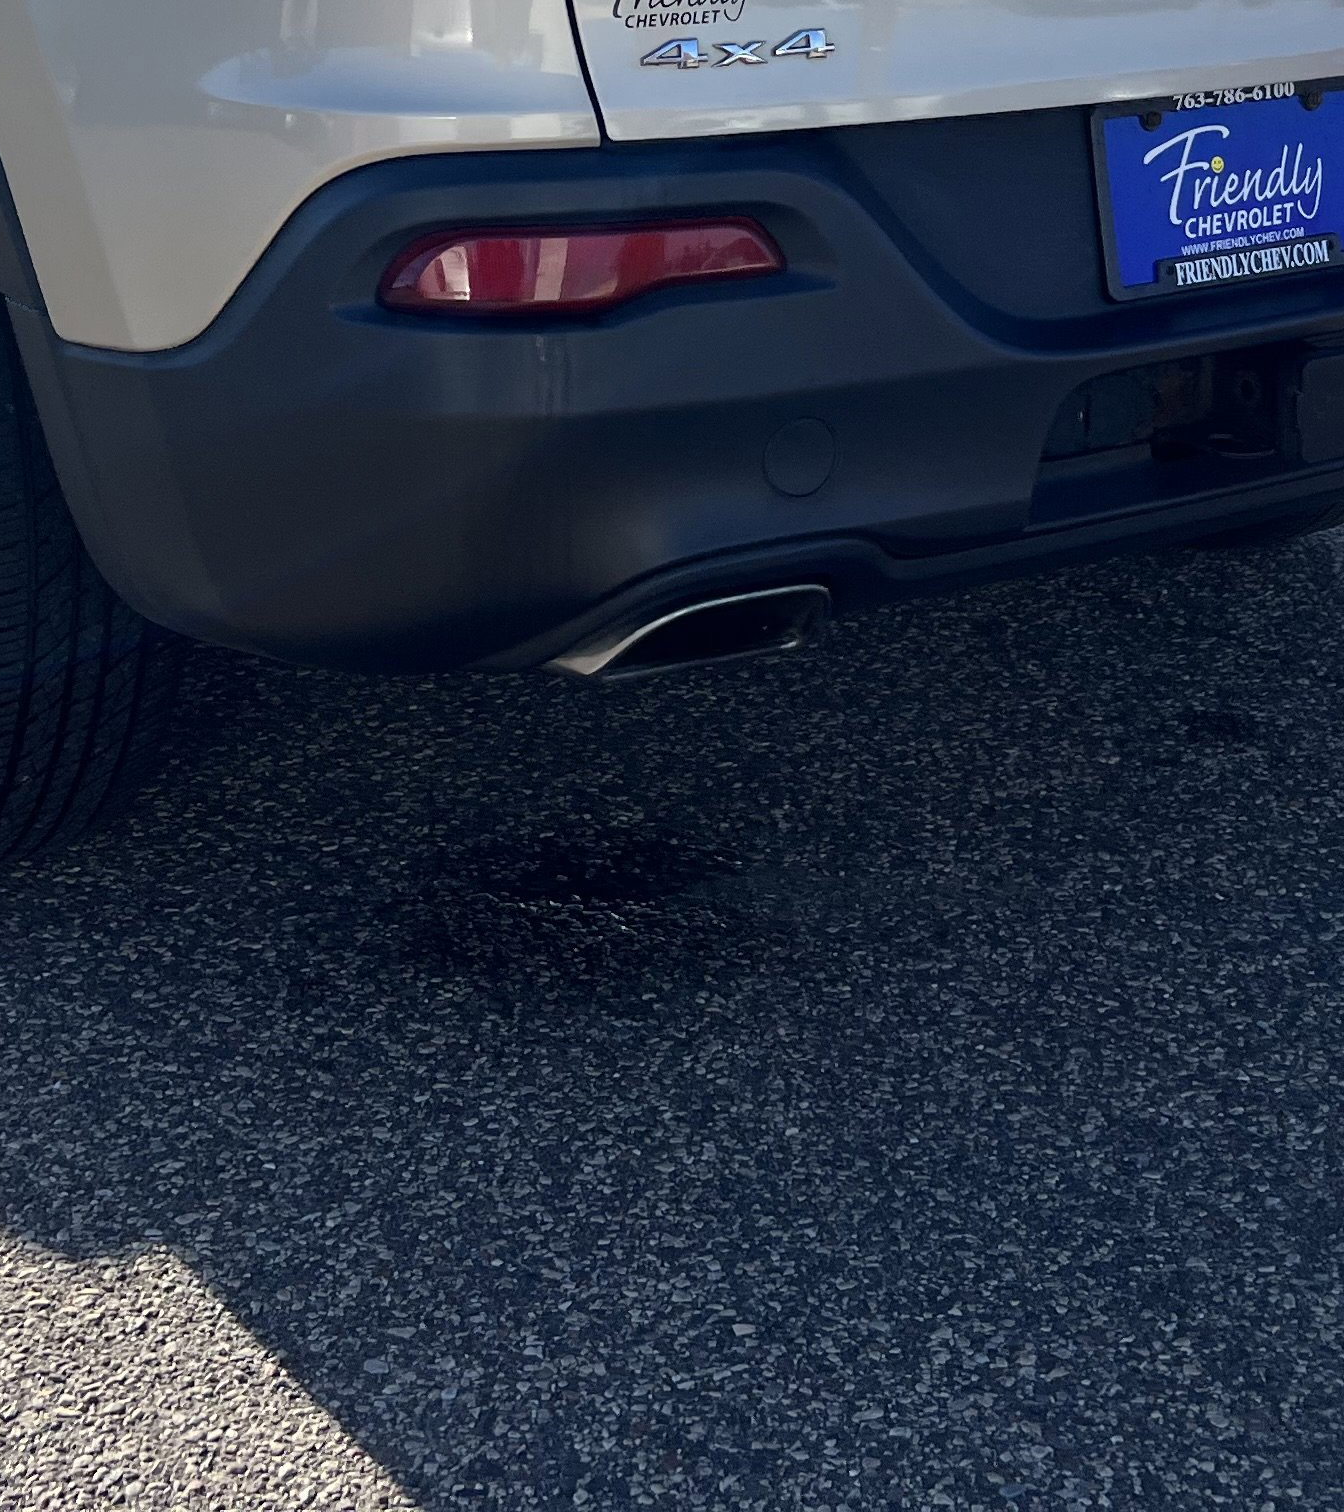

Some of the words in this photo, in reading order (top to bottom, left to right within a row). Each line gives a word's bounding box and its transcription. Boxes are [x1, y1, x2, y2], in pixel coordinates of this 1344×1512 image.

[624, 9, 721, 29] CHEVROLET
[640, 28, 836, 70] 4x4
[1172, 82, 1296, 111] 763-786-6100
[1143, 124, 1323, 225] Friendly
[1185, 203, 1295, 239] CHEVROLET
[1181, 227, 1305, 257] WWW.FRIENDLYCHEV.COM
[1174, 240, 1330, 287] FRIENDLYCHEV.COM
